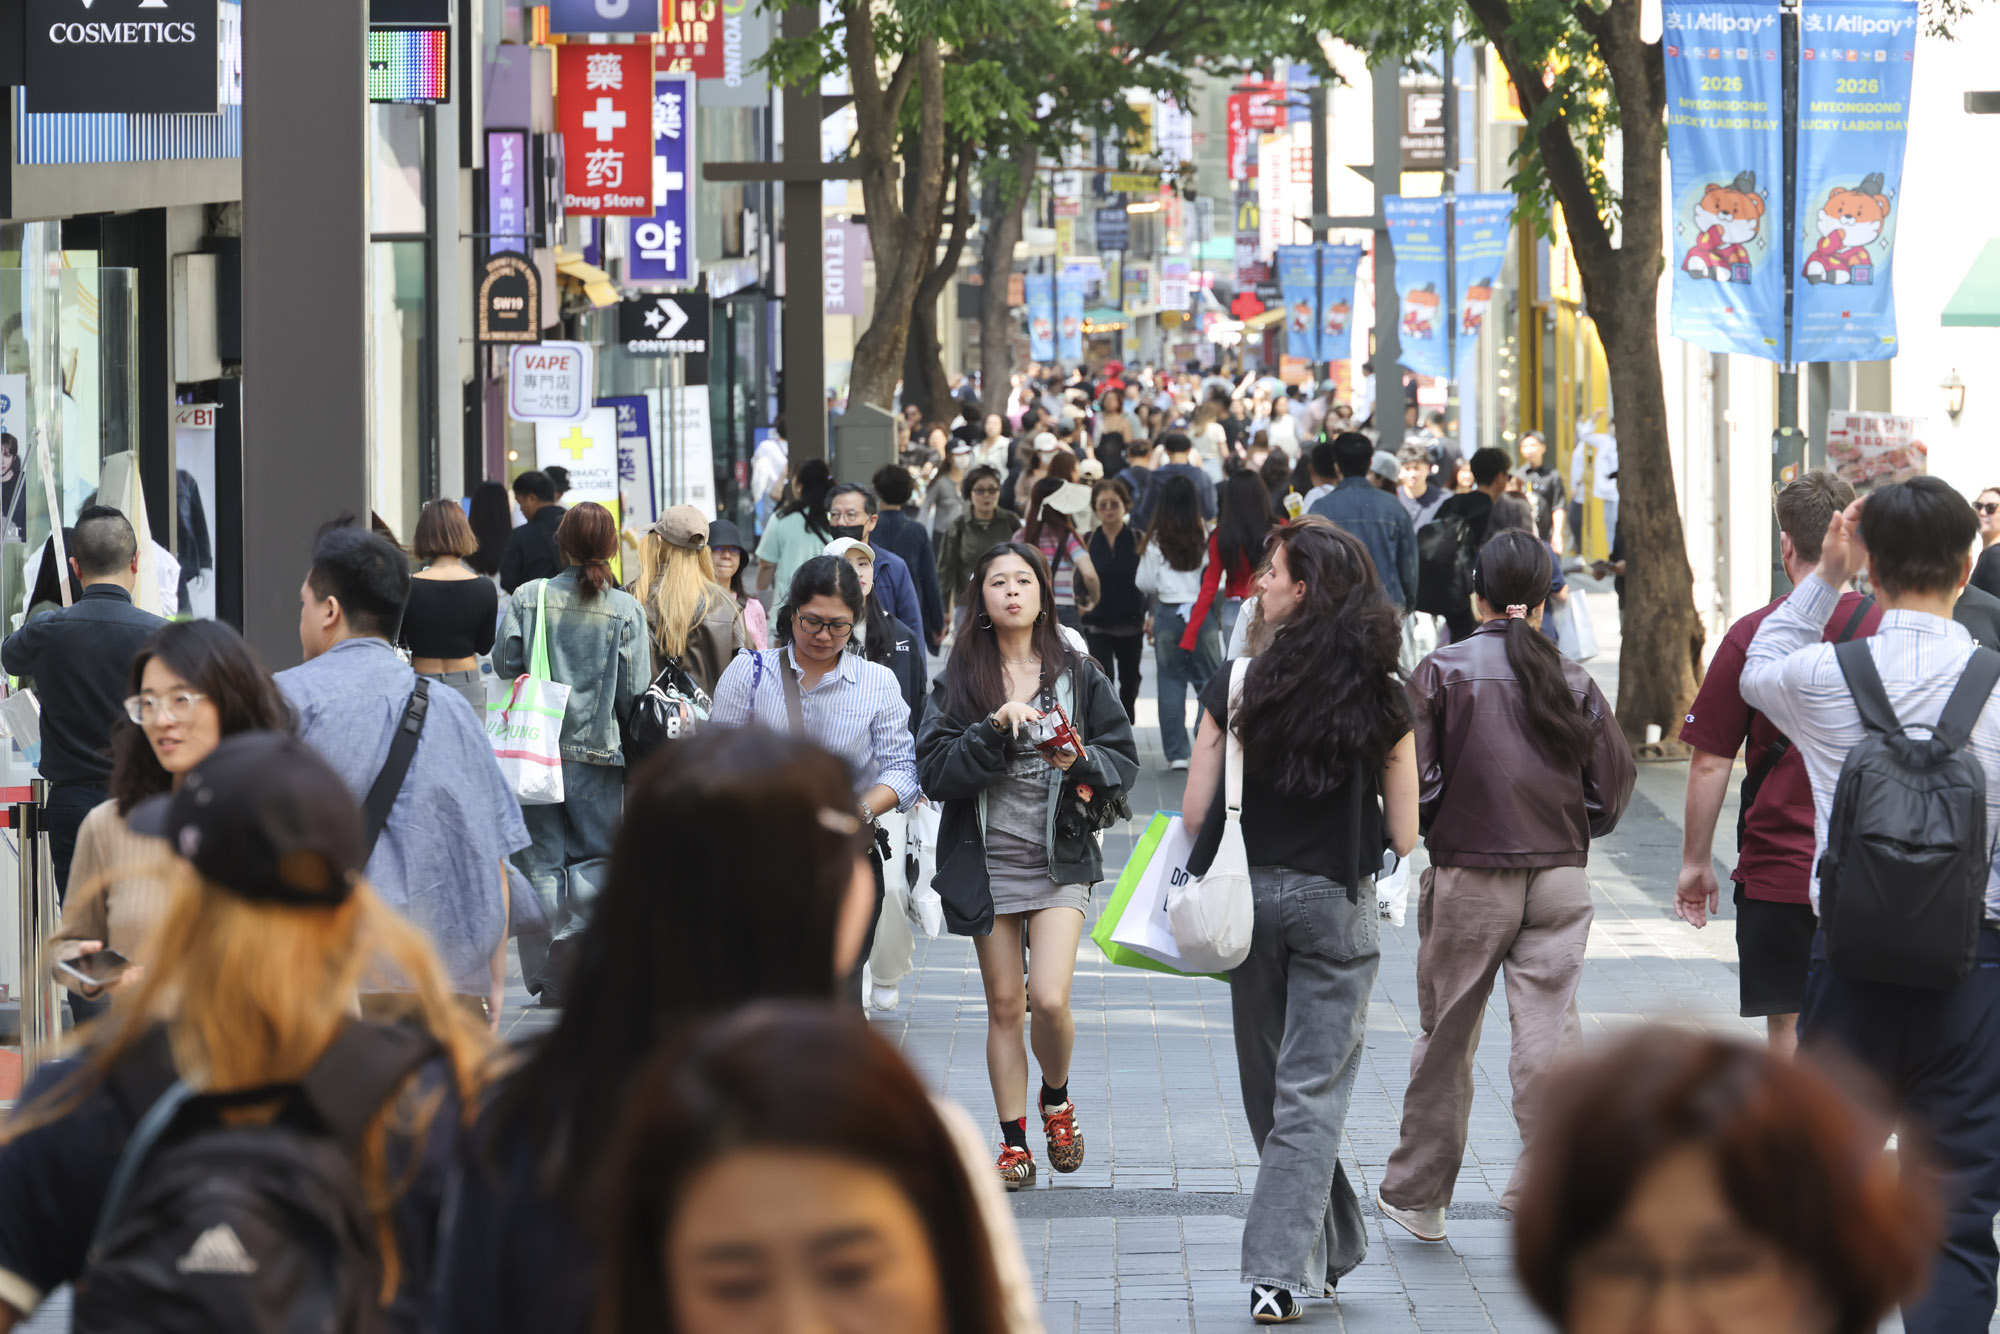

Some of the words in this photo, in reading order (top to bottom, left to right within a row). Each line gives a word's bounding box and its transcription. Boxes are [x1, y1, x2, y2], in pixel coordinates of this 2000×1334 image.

[49, 22, 196, 44] COSMETICS
[723, 15, 742, 88] YOUNG
[586, 53, 623, 90] 藥
[1700, 76, 1743, 92] 2026
[1836, 78, 1879, 94] 2026
[1679, 97, 1768, 112] MYEONGDONG
[1810, 101, 1902, 113] MYEONGDONG
[1669, 114, 1706, 128] LUCKY
[1709, 117, 1750, 130] LABOR
[1752, 120, 1778, 131] DAY
[1801, 120, 1839, 130] LUCKY
[1842, 120, 1883, 131] LABOR
[500, 136, 515, 186] VAPE
[584, 148, 625, 188] 药
[563, 194, 600, 209] Drug
[603, 194, 645, 207] Store
[635, 219, 682, 272] 약
[824, 228, 845, 308] ETUDE
[628, 340, 706, 352] CONVERSE
[525, 355, 570, 371] VAPE
[194, 409, 213, 426] B1
[667, 716, 681, 739] 8
[1378, 901, 1390, 909] OF
